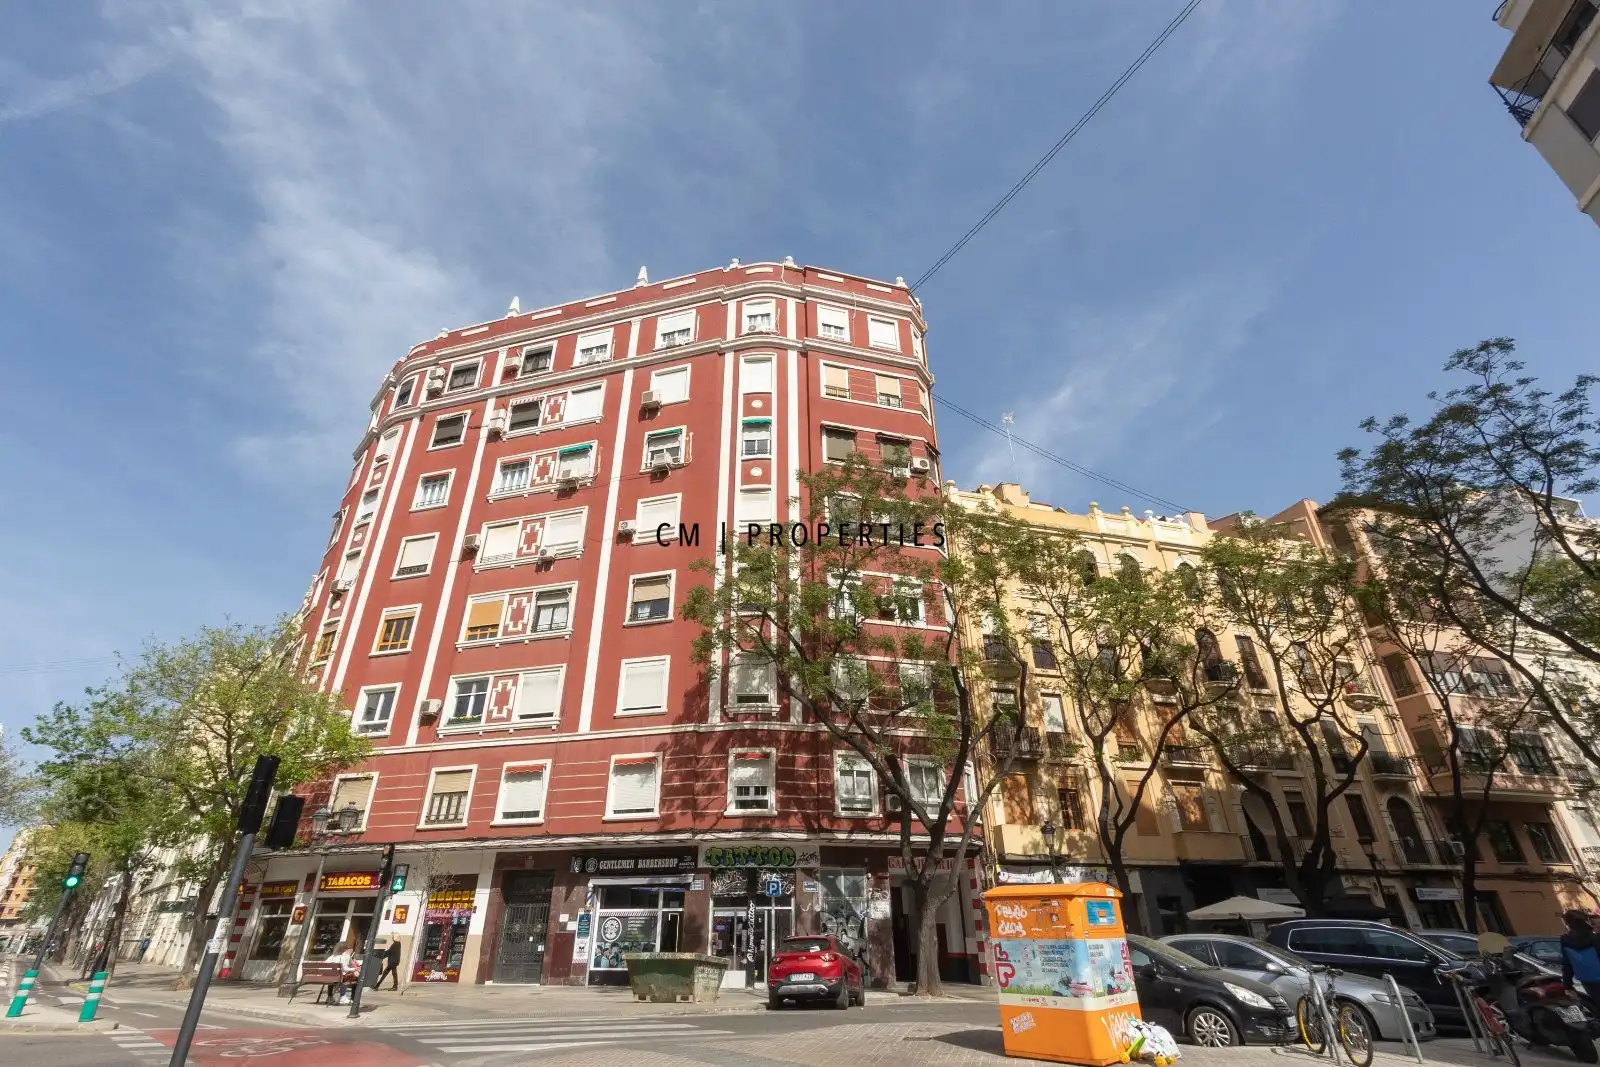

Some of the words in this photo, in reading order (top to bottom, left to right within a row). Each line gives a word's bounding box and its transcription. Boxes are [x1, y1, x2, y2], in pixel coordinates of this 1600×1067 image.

[600, 859, 635, 869] GENTLEMEN
[638, 858, 679, 868] BARBERSHOP
[327, 876, 371, 886] TABACOS
[769, 882, 777, 894] P
